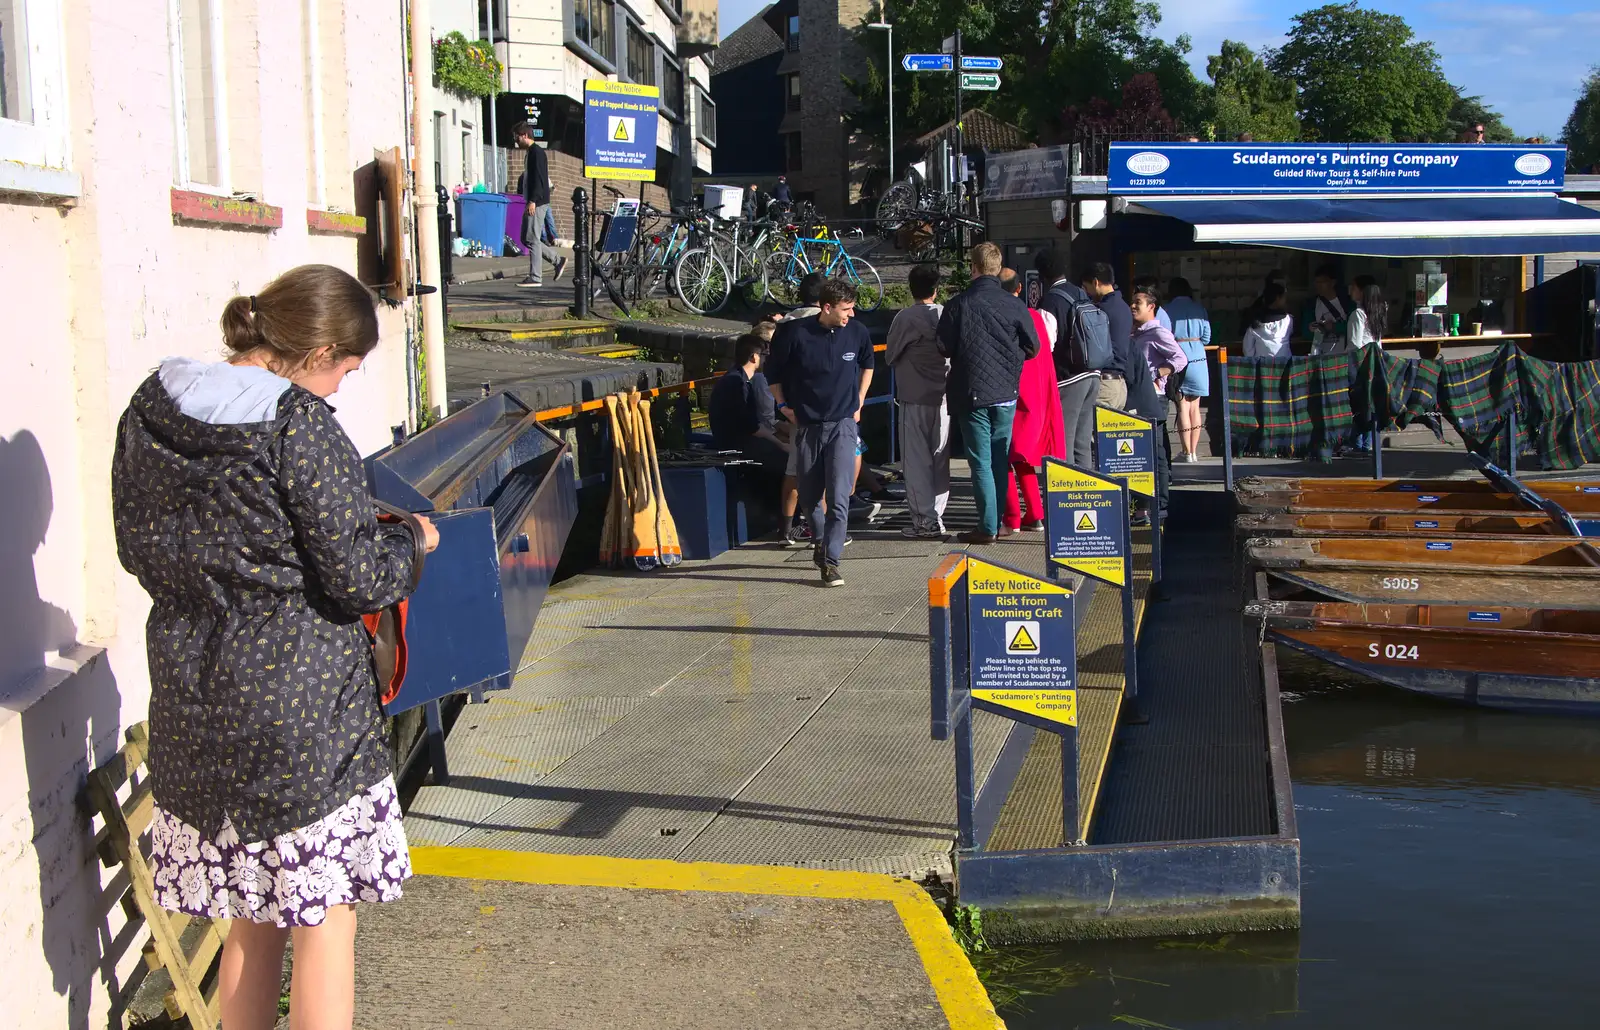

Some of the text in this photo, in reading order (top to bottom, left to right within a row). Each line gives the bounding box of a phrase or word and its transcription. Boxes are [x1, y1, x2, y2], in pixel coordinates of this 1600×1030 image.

[605, 82, 641, 94] Safety Notice
[589, 98, 599, 107] Risk
[606, 100, 623, 110] Trapped
[1233, 152, 1459, 167] Scudamore's Punting Company
[1003, 164, 1027, 172] Scudamore's
[1027, 161, 1042, 171] Punting
[1043, 160, 1063, 168] Company
[1274, 169, 1304, 177] Guided
[973, 580, 1041, 592] Safety Notice
[1383, 578, 1419, 590] S005
[996, 596, 1047, 606] Risk from
[982, 608, 1062, 620] Incoming Craft
[1368, 643, 1419, 660] S 024
[1042, 694, 1072, 702] Punting
[1036, 703, 1072, 711] Company
